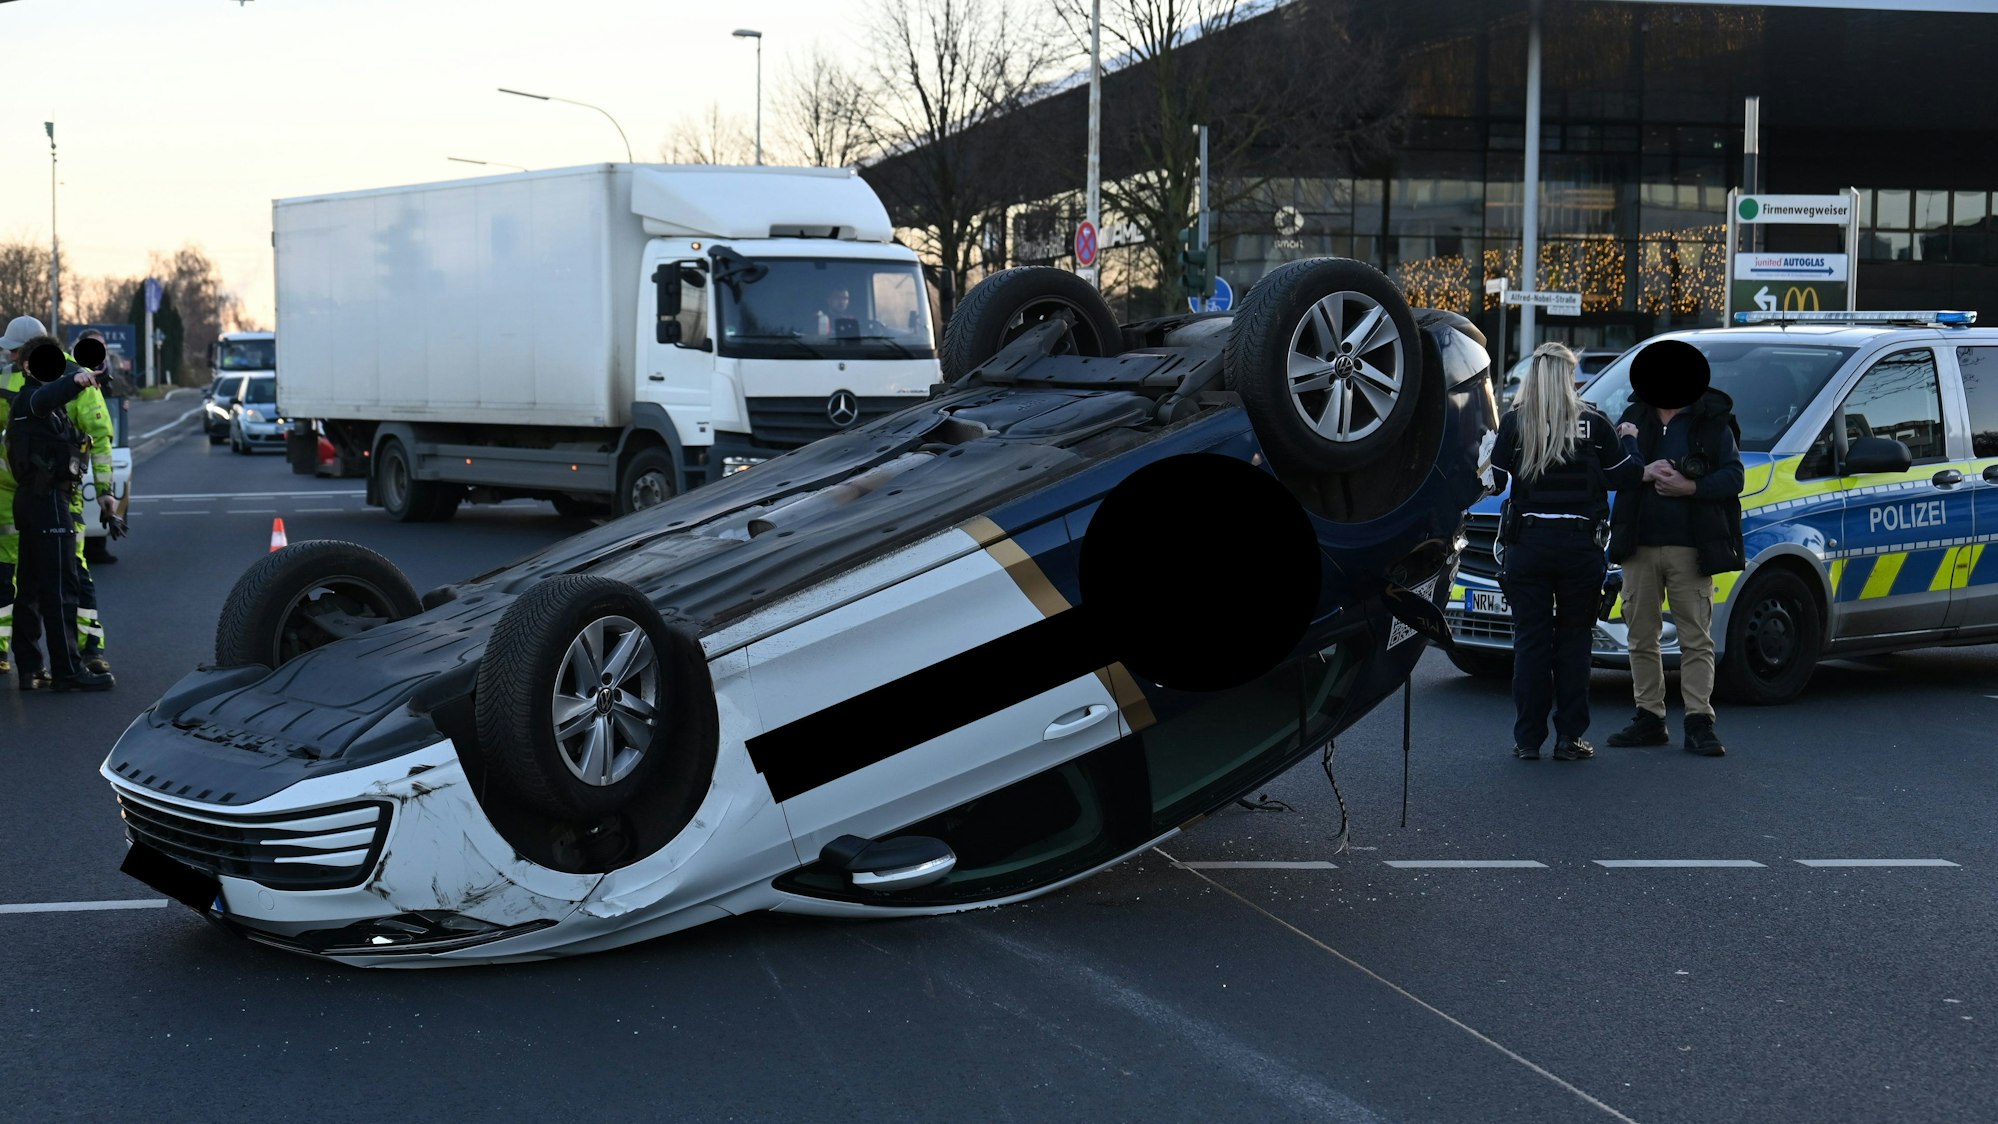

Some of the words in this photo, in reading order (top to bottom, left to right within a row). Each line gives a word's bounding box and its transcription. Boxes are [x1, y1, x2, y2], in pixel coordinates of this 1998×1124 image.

[1762, 203, 1848, 218] Firmenwegweiser
[1755, 257, 1782, 267] junited
[1783, 257, 1825, 267] AUTOGLAS
[1510, 293, 1577, 304] Alfred-Nobel-Straße
[1870, 500, 1946, 532] POLIZEI
[1473, 593, 1495, 611] NRW
